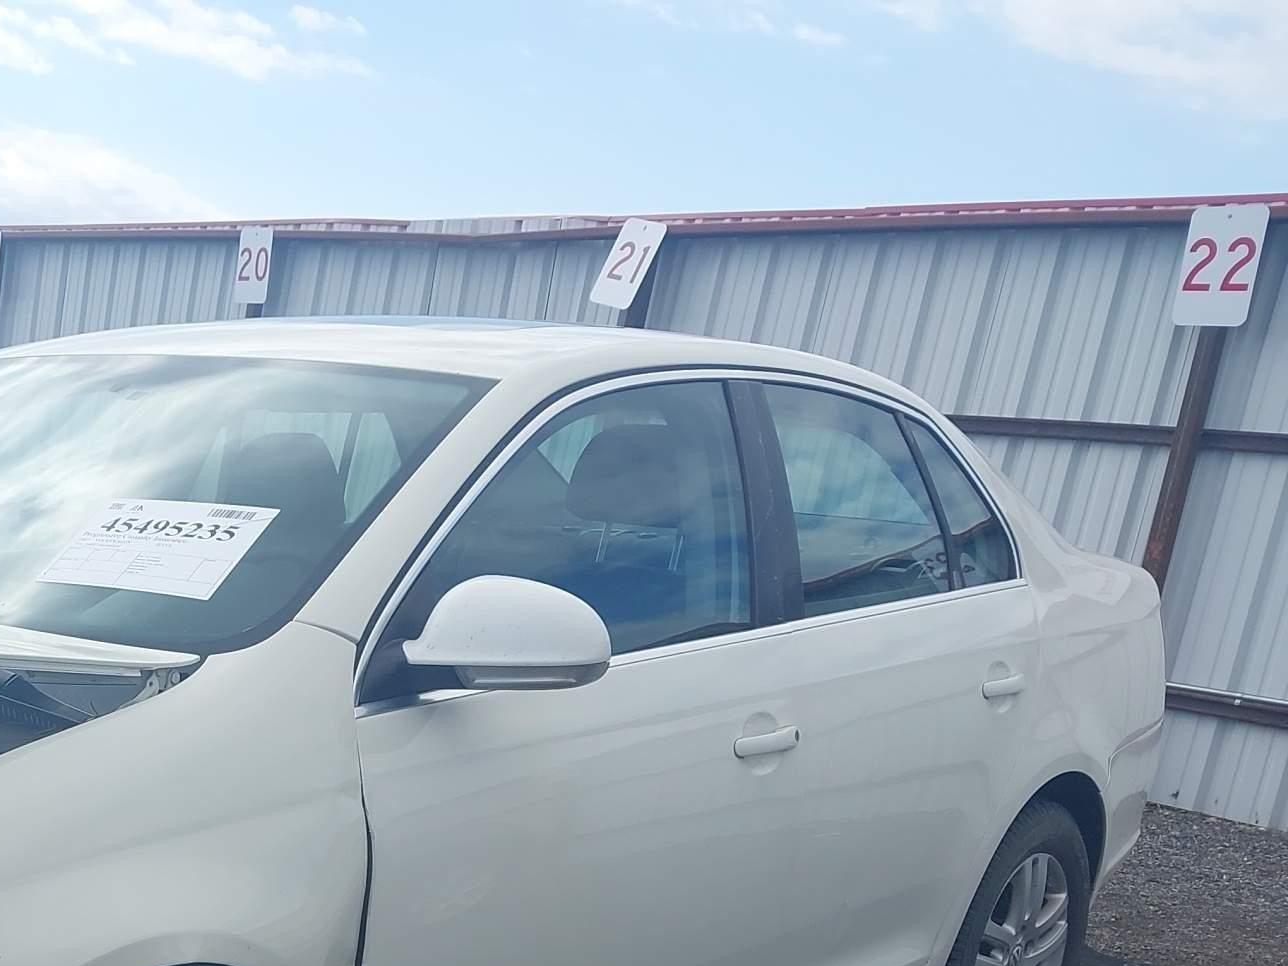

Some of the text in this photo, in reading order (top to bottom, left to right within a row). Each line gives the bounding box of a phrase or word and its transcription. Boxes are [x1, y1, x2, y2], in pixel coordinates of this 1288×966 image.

[237, 247, 269, 282] 20
[607, 241, 651, 284] 21
[1182, 236, 1257, 291] 22
[100, 516, 241, 542] 45495235
